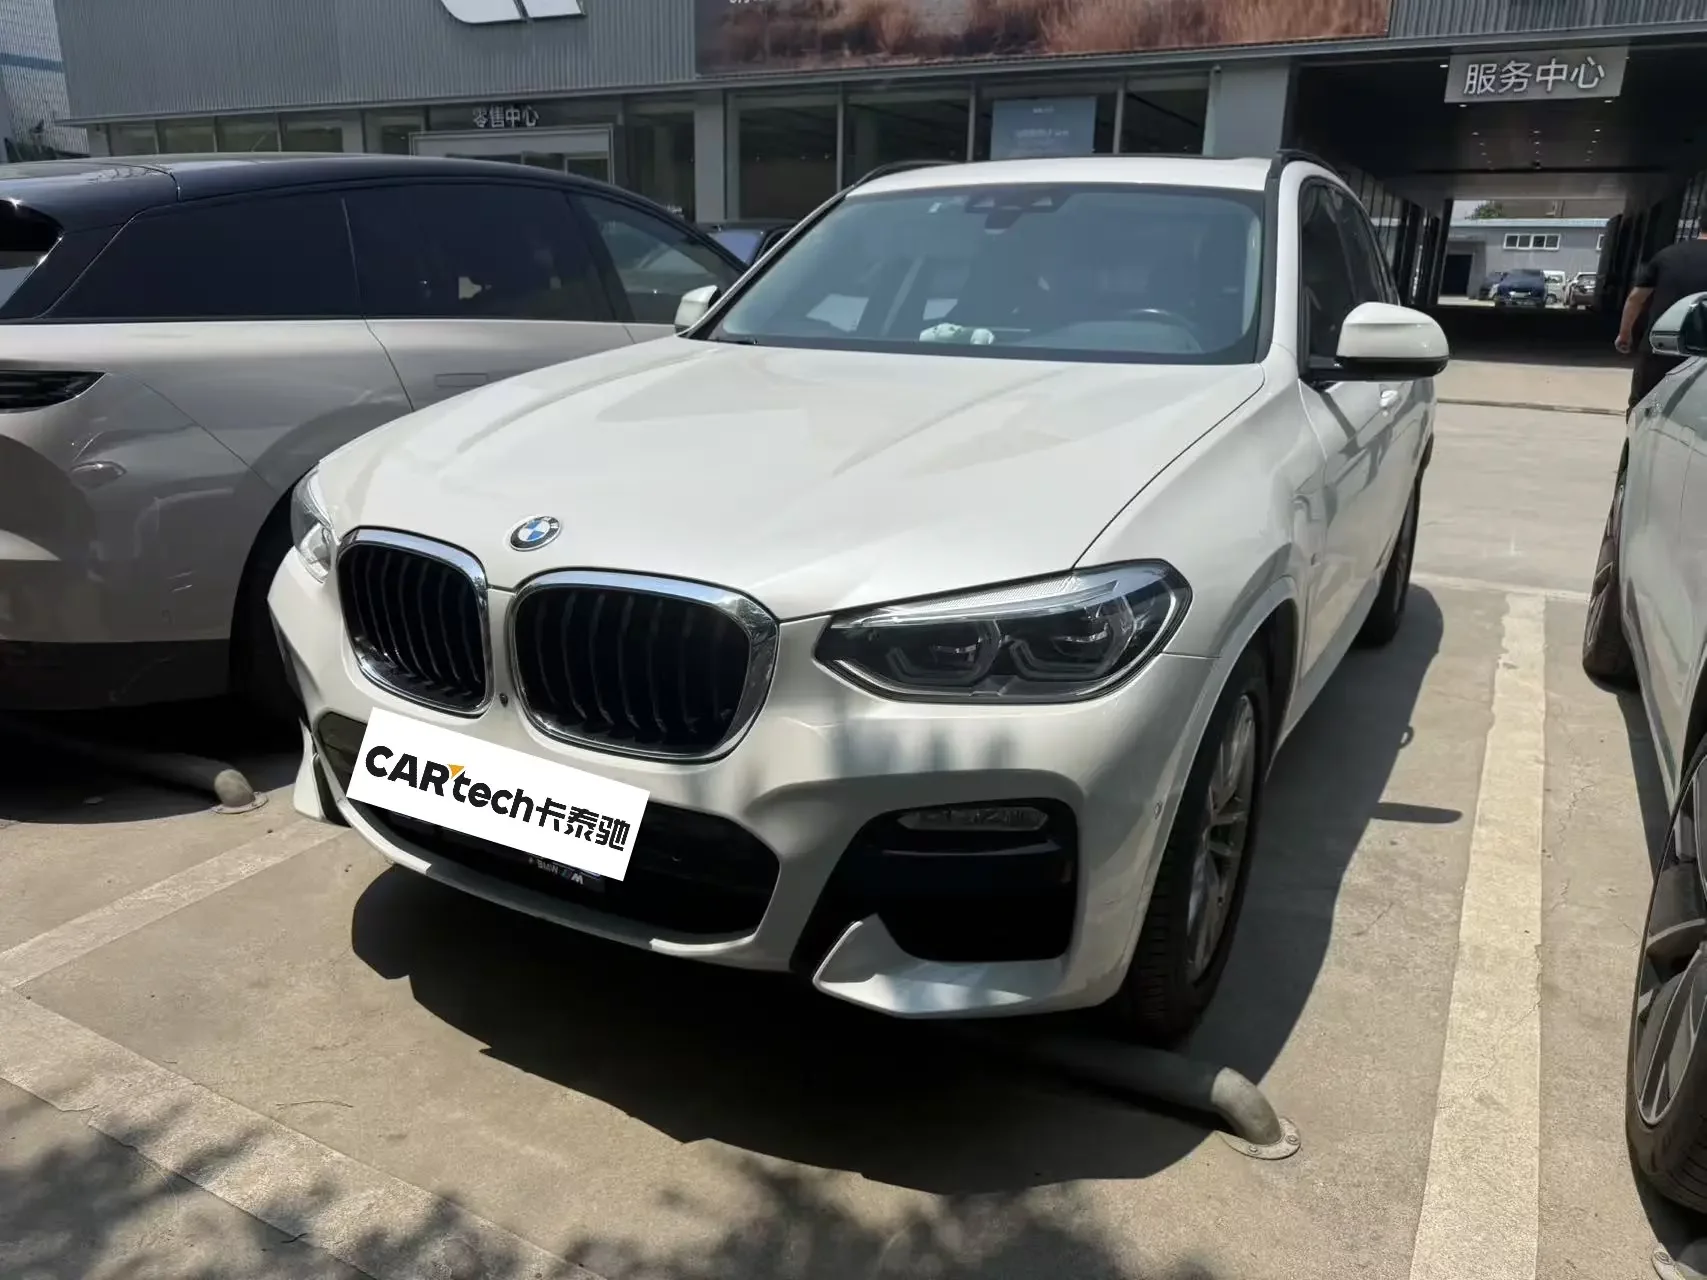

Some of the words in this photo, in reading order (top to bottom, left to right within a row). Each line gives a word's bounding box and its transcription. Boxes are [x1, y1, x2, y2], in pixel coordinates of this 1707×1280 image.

[1463, 56, 1605, 95] 服务中心
[473, 105, 539, 128] 零售中心
